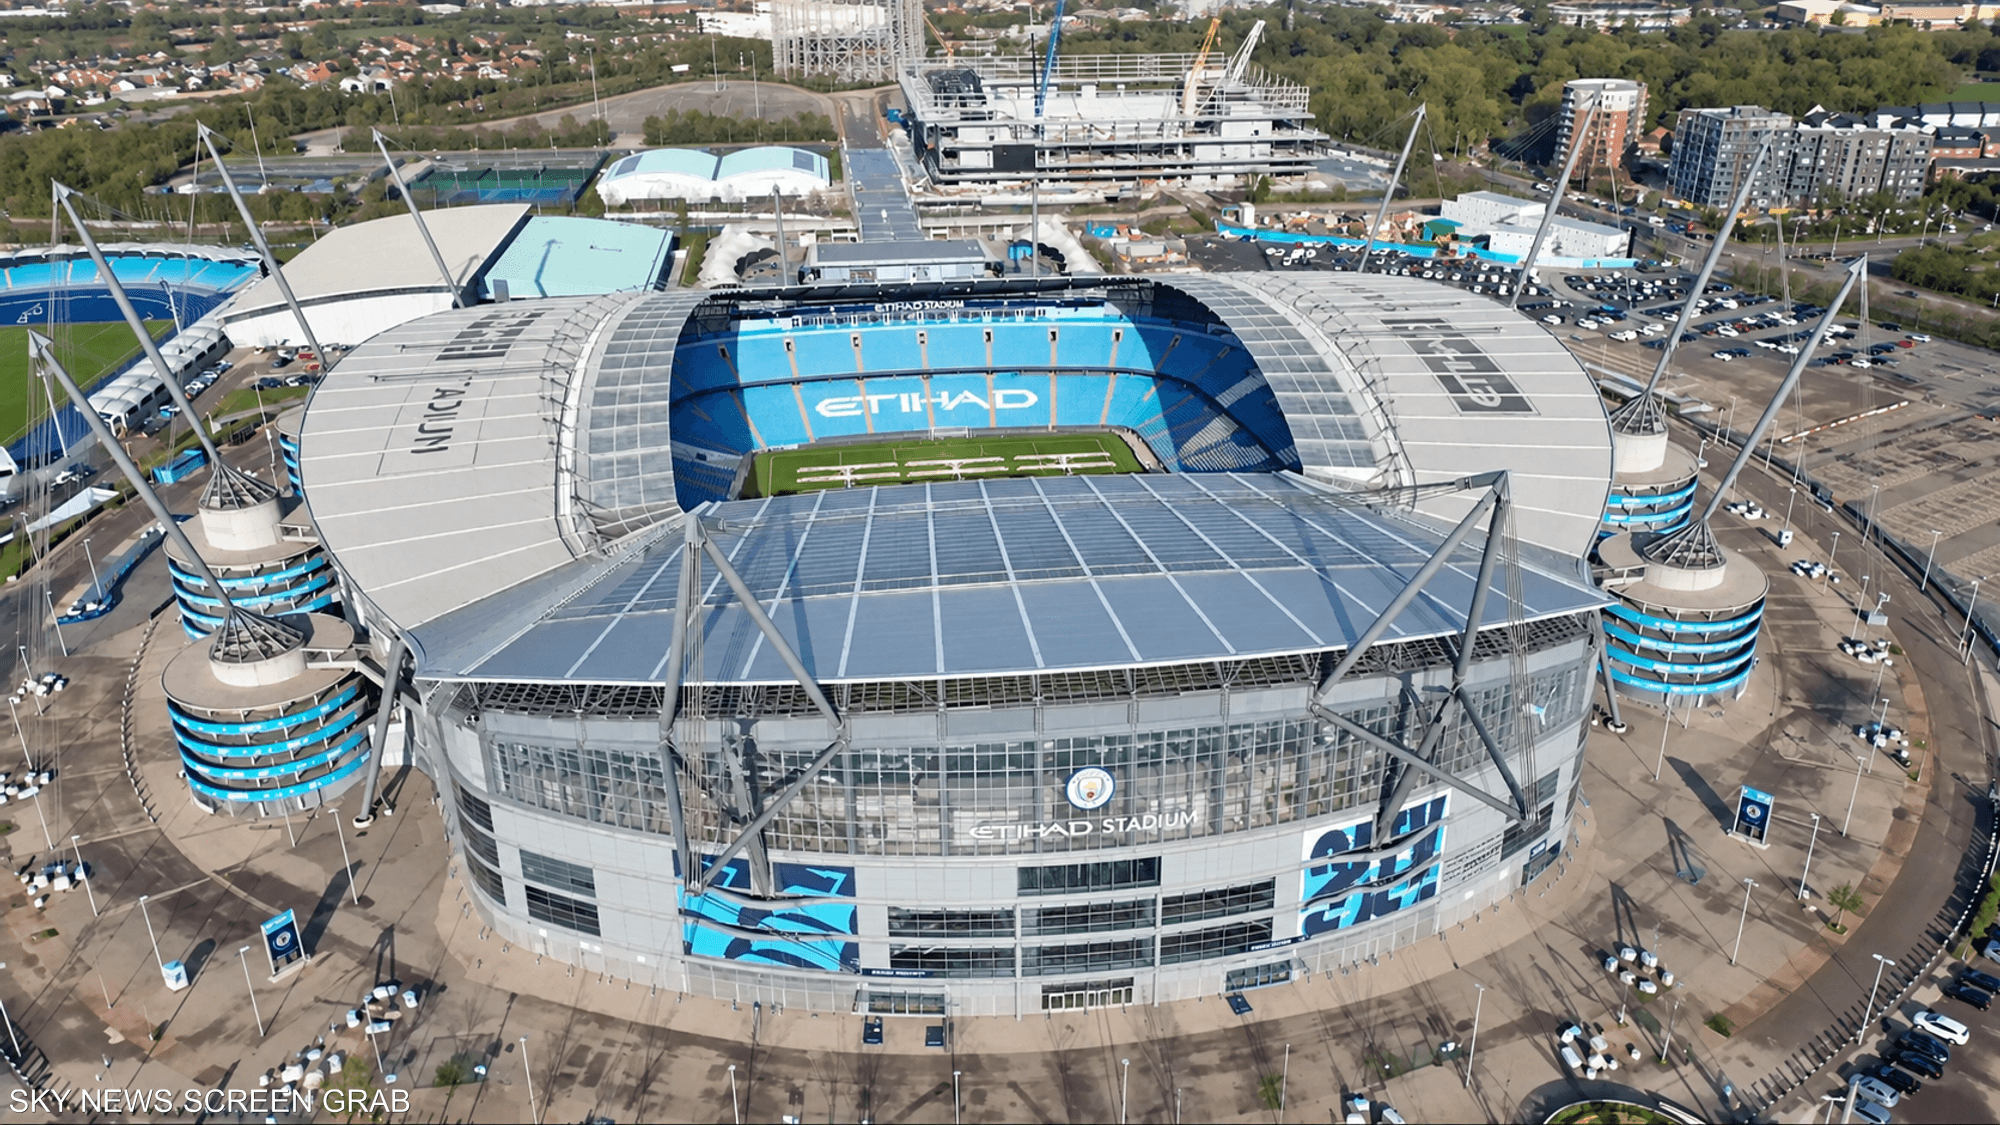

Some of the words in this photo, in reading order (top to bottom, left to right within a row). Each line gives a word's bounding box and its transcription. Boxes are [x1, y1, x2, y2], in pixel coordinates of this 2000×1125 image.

[924, 300, 964, 310] STADIUM
[815, 389, 1038, 417] ETIHAD
[970, 821, 1093, 838] ETIHAD
[1102, 811, 1198, 833] STADIUM
